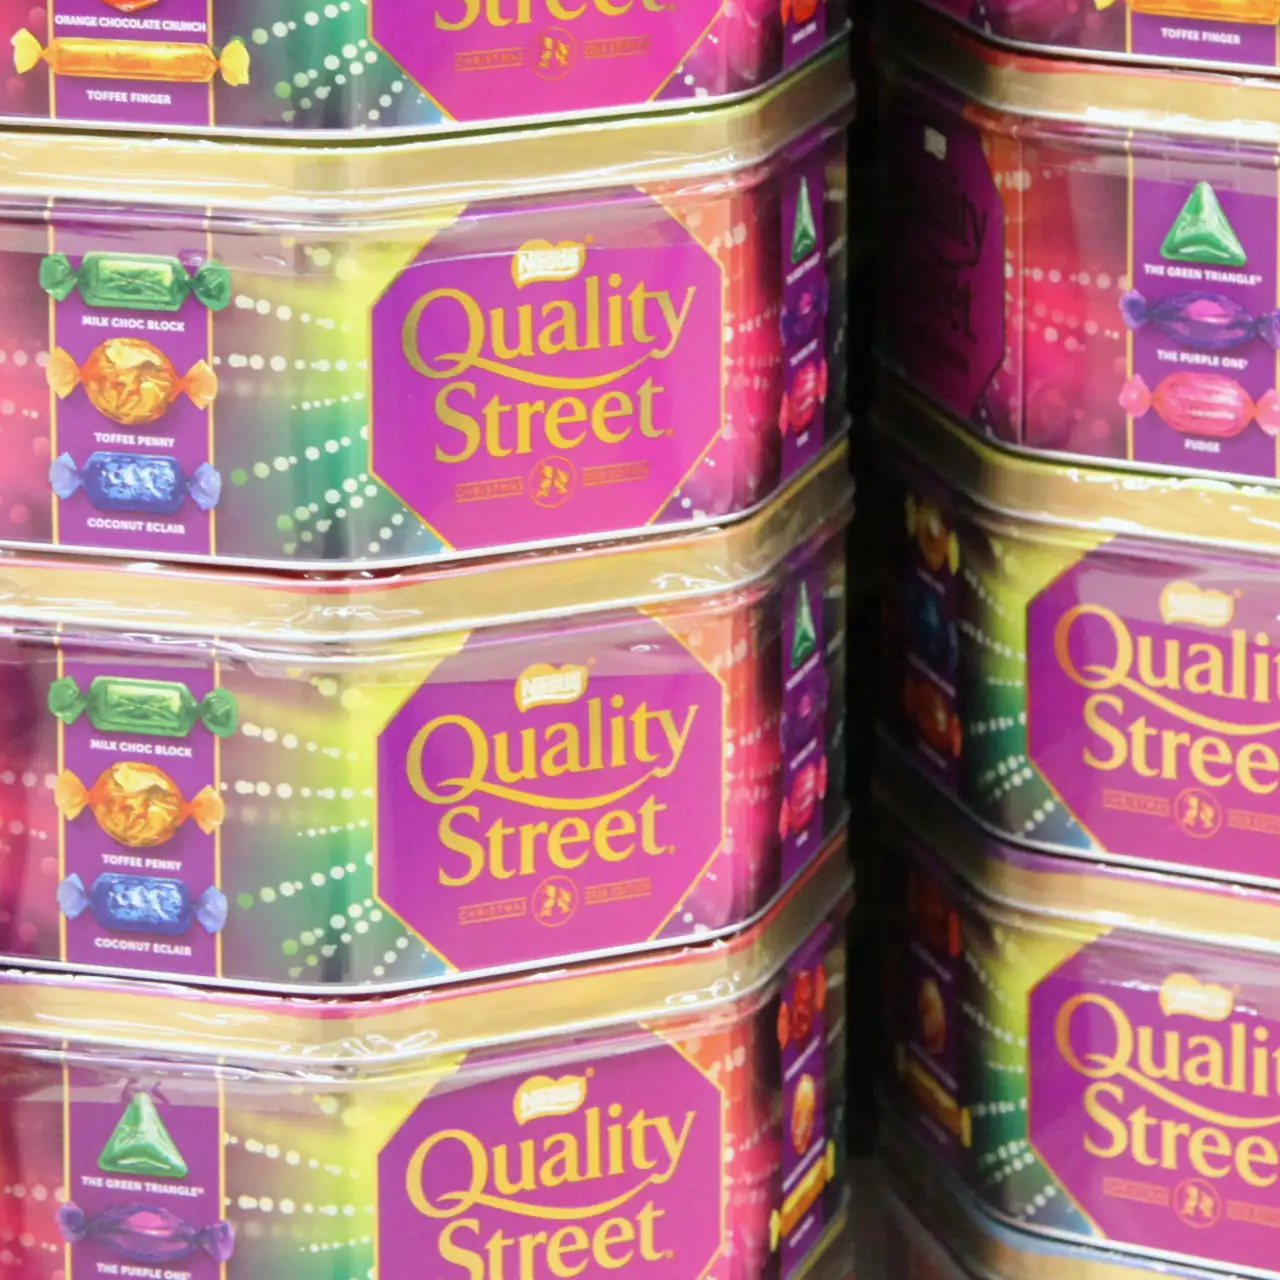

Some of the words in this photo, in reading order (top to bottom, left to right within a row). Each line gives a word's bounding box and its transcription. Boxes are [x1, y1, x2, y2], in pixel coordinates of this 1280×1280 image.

[54, 15, 97, 27] ORANGE
[97, 17, 161, 29] CHOCOLATE
[161, 20, 206, 32] CRUNCH
[1162, 28, 1199, 40] TOFFEE
[1202, 32, 1240, 44] FINGER
[87, 90, 128, 102] TOFFEE
[130, 93, 171, 104] FINGER
[1144, 264, 1165, 275] THE
[1167, 267, 1202, 279] GREEN
[82, 316, 109, 326] MILK
[111, 318, 144, 329] CHOC
[147, 320, 184, 331] BLOCK
[402, 273, 697, 388] Quality
[1157, 350, 1178, 361] THE
[1179, 353, 1219, 366] PURPLE
[434, 376, 665, 463] Street
[95, 433, 135, 444] TOFFEE
[137, 436, 174, 447] PENNY
[1184, 440, 1220, 452] FUDGE
[87, 518, 143, 530] COCONUT
[146, 522, 185, 534] ECLAIR
[91, 740, 117, 750] MILK
[119, 742, 152, 753] CHOC
[155, 745, 192, 757] BLOCK
[406, 694, 698, 808] Quality
[438, 794, 671, 887] Street
[102, 855, 142, 867] TOFFEE
[145, 859, 181, 870] PENNY
[95, 938, 151, 951] COCONUT
[153, 944, 191, 955] ECLAIR
[405, 1103, 697, 1219] Quality
[82, 1176, 103, 1187] THE
[105, 1179, 142, 1190] GREEN
[438, 1204, 671, 1280] Street
[97, 1263, 118, 1274] THE
[121, 1266, 162, 1279] PURPLE
